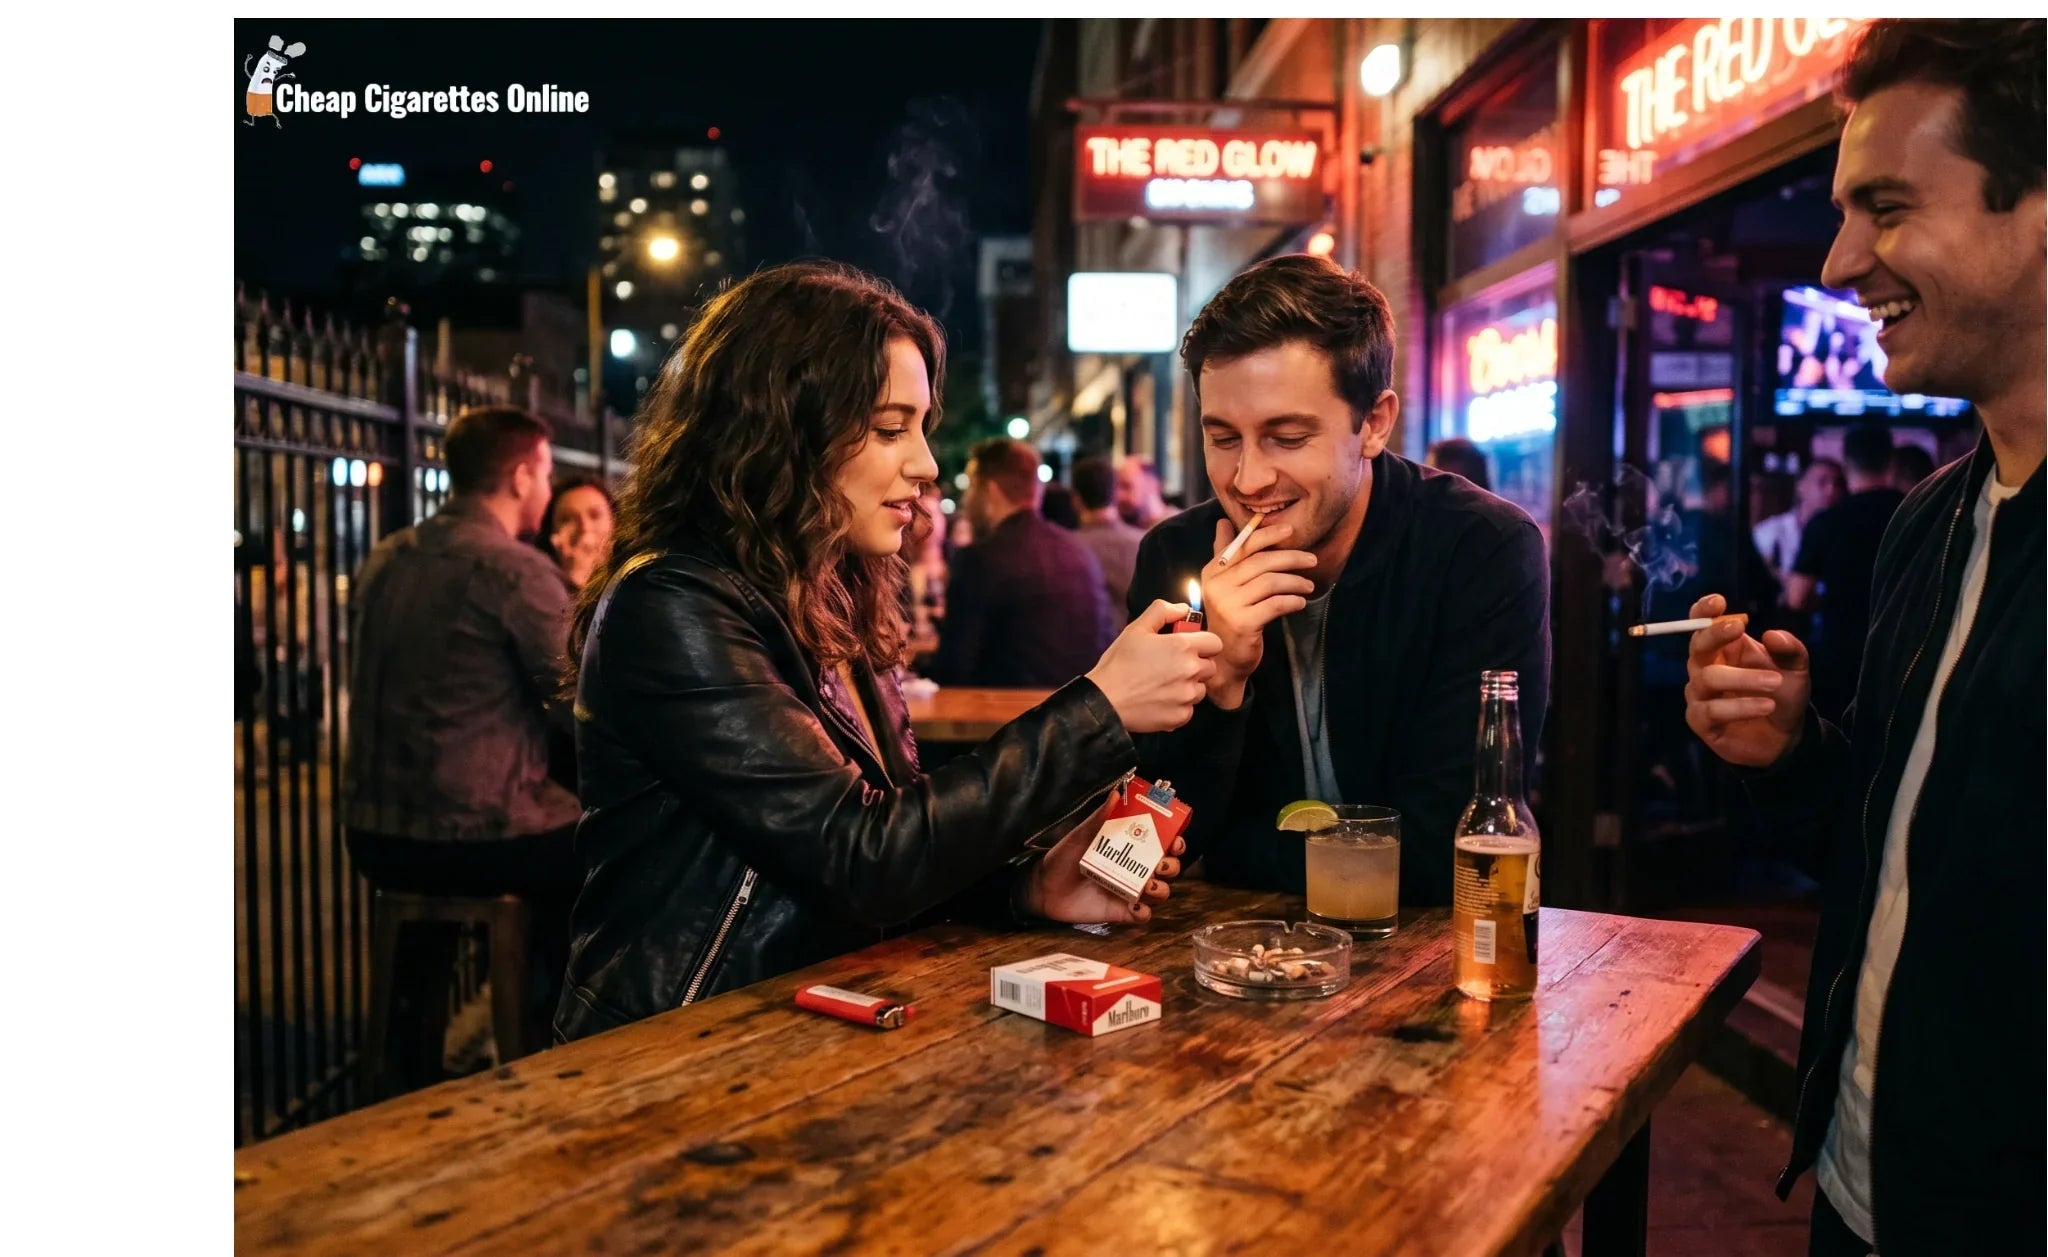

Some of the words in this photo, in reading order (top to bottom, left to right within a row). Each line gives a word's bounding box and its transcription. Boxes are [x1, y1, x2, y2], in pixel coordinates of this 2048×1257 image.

[1621, 43, 1688, 148] THE
[1692, 18, 1774, 112] RED
[1086, 137, 1152, 176] THE
[1155, 138, 1219, 177] RED
[1222, 140, 1317, 178] GLOW
[1093, 835, 1149, 879] Marlboro
[1108, 1000, 1150, 1028] Marlboro
